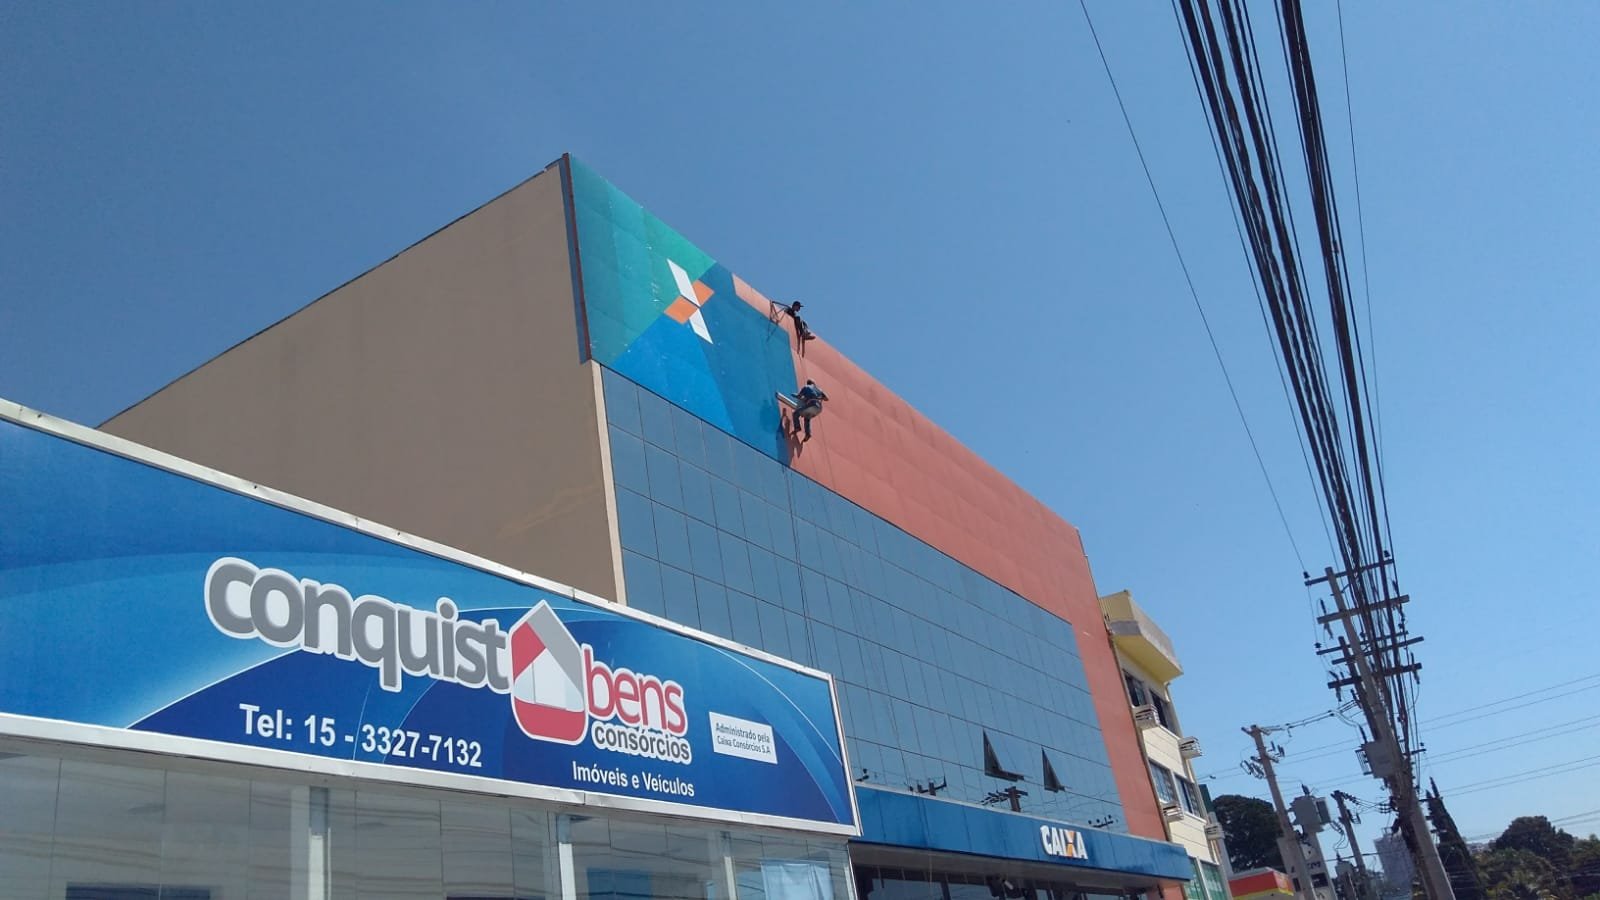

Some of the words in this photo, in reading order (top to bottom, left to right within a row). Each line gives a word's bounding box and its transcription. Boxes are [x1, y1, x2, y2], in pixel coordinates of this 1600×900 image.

[207, 561, 509, 691] conquist
[584, 648, 687, 735] bens
[239, 703, 292, 740] Tel:
[304, 714, 336, 746] 15
[361, 723, 483, 767] 3327-7132
[594, 725, 690, 761] consórcios
[715, 722, 757, 740] Administrado
[757, 732, 770, 743] pela
[717, 735, 732, 747] Caixa
[572, 761, 628, 787] Imóveis
[631, 774, 640, 788] e
[642, 771, 695, 797] Veículos
[1040, 825, 1088, 859] CAIXA
